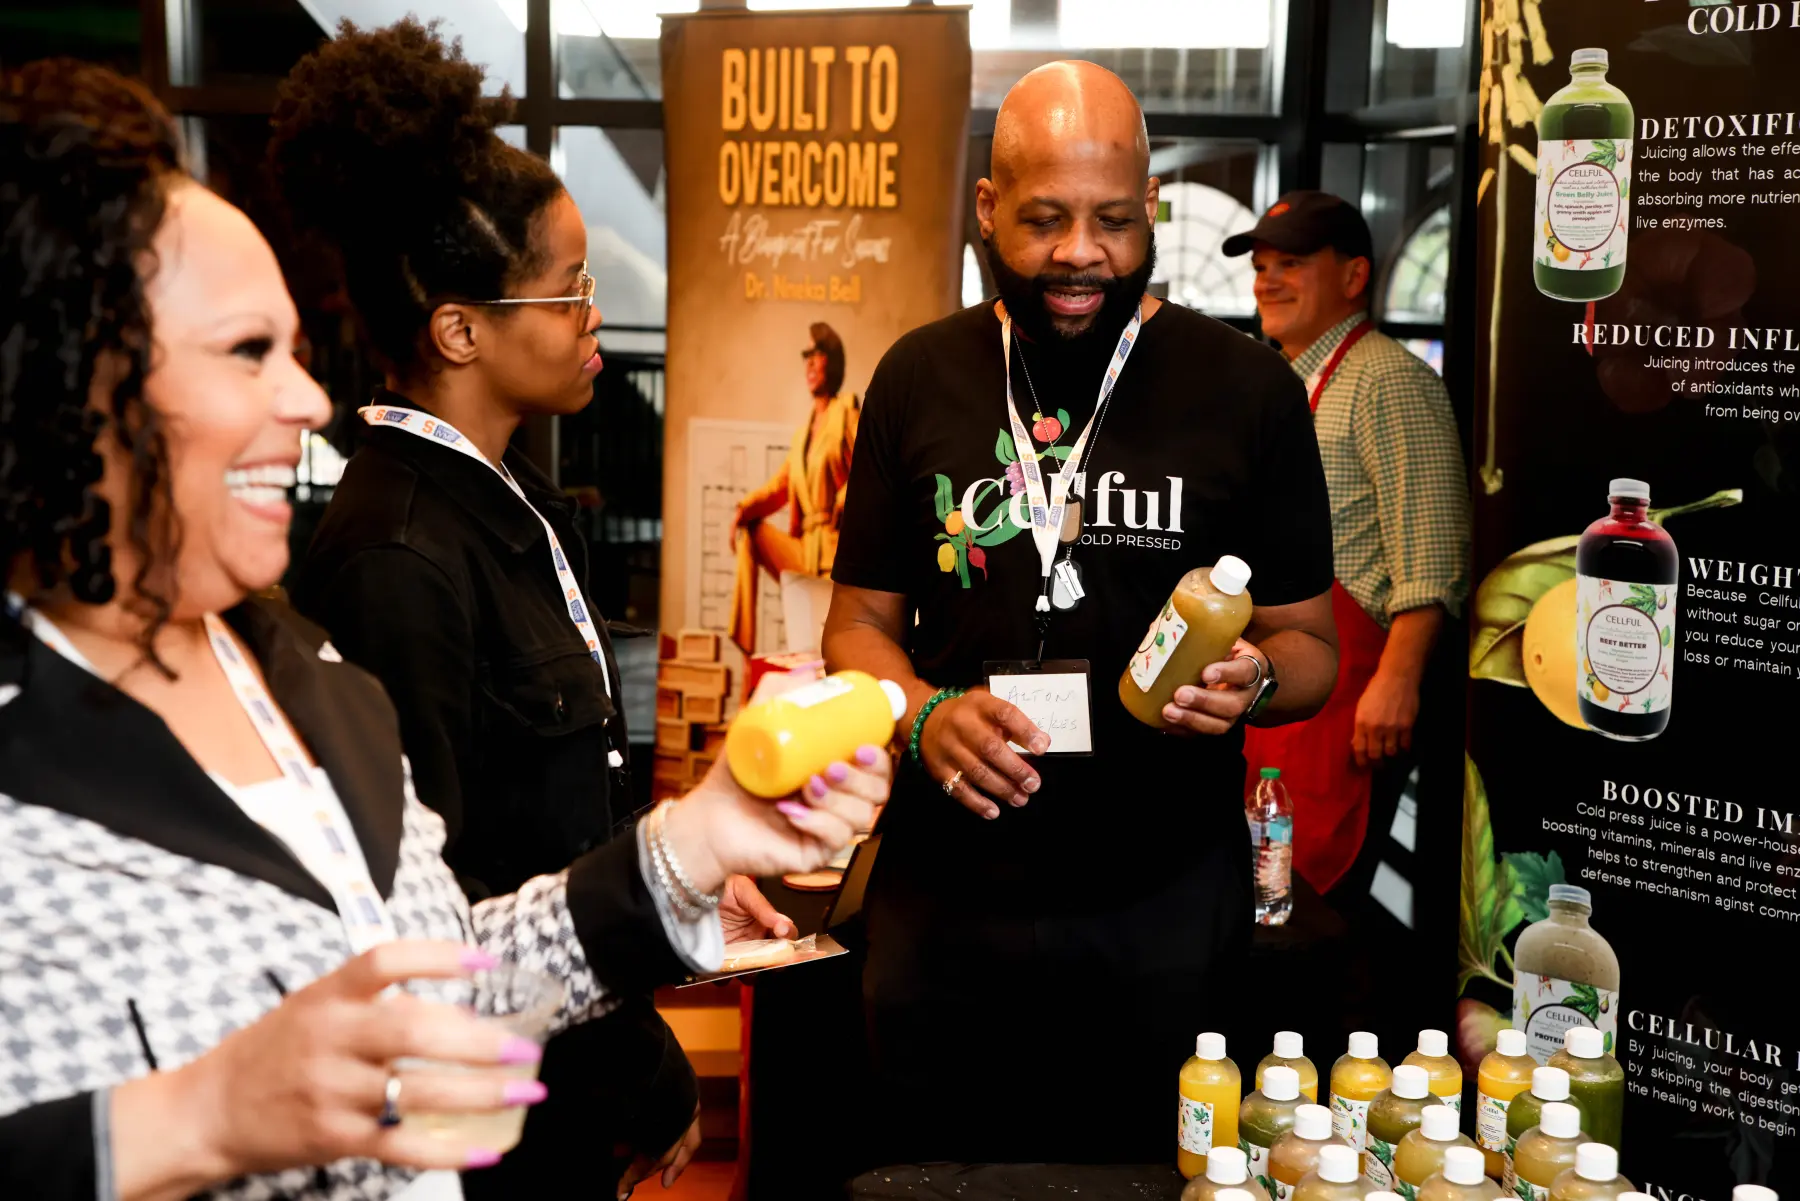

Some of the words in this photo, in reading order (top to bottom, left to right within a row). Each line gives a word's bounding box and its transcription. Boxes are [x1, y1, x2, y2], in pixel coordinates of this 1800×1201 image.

[1687, 3, 1781, 35] COLD
[722, 46, 835, 132] BUILT
[846, 45, 898, 132] TO
[1640, 112, 1800, 140] DETOXIFI
[1640, 145, 1687, 162] Juicing
[1692, 144, 1737, 158] allows
[1741, 142, 1766, 156] the
[1770, 141, 1800, 156] effe
[719, 140, 898, 208] OVERCOME
[1568, 169, 1604, 178] CELLFUL
[1638, 169, 1661, 183] the
[1668, 168, 1703, 185] body
[1711, 167, 1740, 181] that
[1748, 166, 1774, 180] has
[1783, 168, 1800, 180] ac
[1577, 191, 1595, 199] Belly
[1637, 191, 1703, 208] absorbing
[1708, 194, 1746, 205] more
[1751, 191, 1800, 204] nutrien
[1636, 215, 1658, 229] live
[1662, 217, 1727, 232] enzymes.
[1571, 323, 1715, 348] REDUCED
[1727, 327, 1800, 351] INFL
[1643, 355, 1690, 373] Juicing
[1694, 358, 1768, 373] introduces
[1772, 360, 1796, 374] the
[1671, 379, 1686, 392] of
[1690, 381, 1774, 397] antioxidants
[1779, 384, 1800, 398] wh
[1705, 403, 1738, 418] from
[1742, 405, 1779, 424] being
[1076, 533, 1112, 546] OLD
[1116, 534, 1181, 550] PRESSED
[1688, 557, 1800, 589] WEIGH
[1687, 583, 1747, 603] Because
[1605, 614, 1643, 627] CELLFUL
[1686, 608, 1738, 624] without
[1743, 615, 1781, 631] sugar
[1599, 637, 1618, 646] BEET
[1618, 641, 1647, 649] BETTER
[1685, 630, 1709, 646] you
[1715, 633, 1764, 649] reduce
[1684, 648, 1710, 665] loss
[1714, 656, 1729, 667] or
[1733, 658, 1792, 675] maintain
[1576, 802, 1606, 818] Cold
[1609, 808, 1644, 827] press
[1649, 818, 1682, 832] juice
[1686, 825, 1696, 836] is
[1700, 827, 1709, 838] a
[1603, 780, 1743, 823] BOOSTED
[1756, 807, 1800, 836] IM
[1542, 817, 1597, 841] boosting
[1602, 830, 1656, 851] vitamins,
[1660, 842, 1716, 861] minerals
[1720, 853, 1745, 867] and
[1749, 856, 1772, 872] live
[1776, 864, 1800, 878] enz
[1588, 846, 1620, 864] helps
[1624, 854, 1638, 867] to
[1642, 859, 1712, 882] strengthen
[1716, 874, 1741, 888] and
[1745, 880, 1797, 900] protect
[1580, 867, 1632, 887] defense
[1635, 880, 1710, 904] mechanism
[1714, 896, 1755, 912] aginst
[1545, 1010, 1585, 1026] CELLFUL
[1627, 1010, 1782, 1067] CELLULAR
[1629, 1039, 1646, 1057] By
[1652, 1046, 1696, 1071] juicing,
[1703, 1061, 1733, 1076] your
[1739, 1067, 1773, 1090] body
[1780, 1082, 1800, 1096] ge
[1628, 1060, 1642, 1076] by
[1651, 1067, 1703, 1093] skipping
[1709, 1081, 1731, 1098] the
[1738, 1090, 1800, 1117] digestion
[1627, 1081, 1649, 1096] the
[1653, 1087, 1697, 1112] healing
[1702, 1103, 1735, 1120] work
[1739, 1111, 1754, 1125] to
[1758, 1115, 1796, 1137] begin
